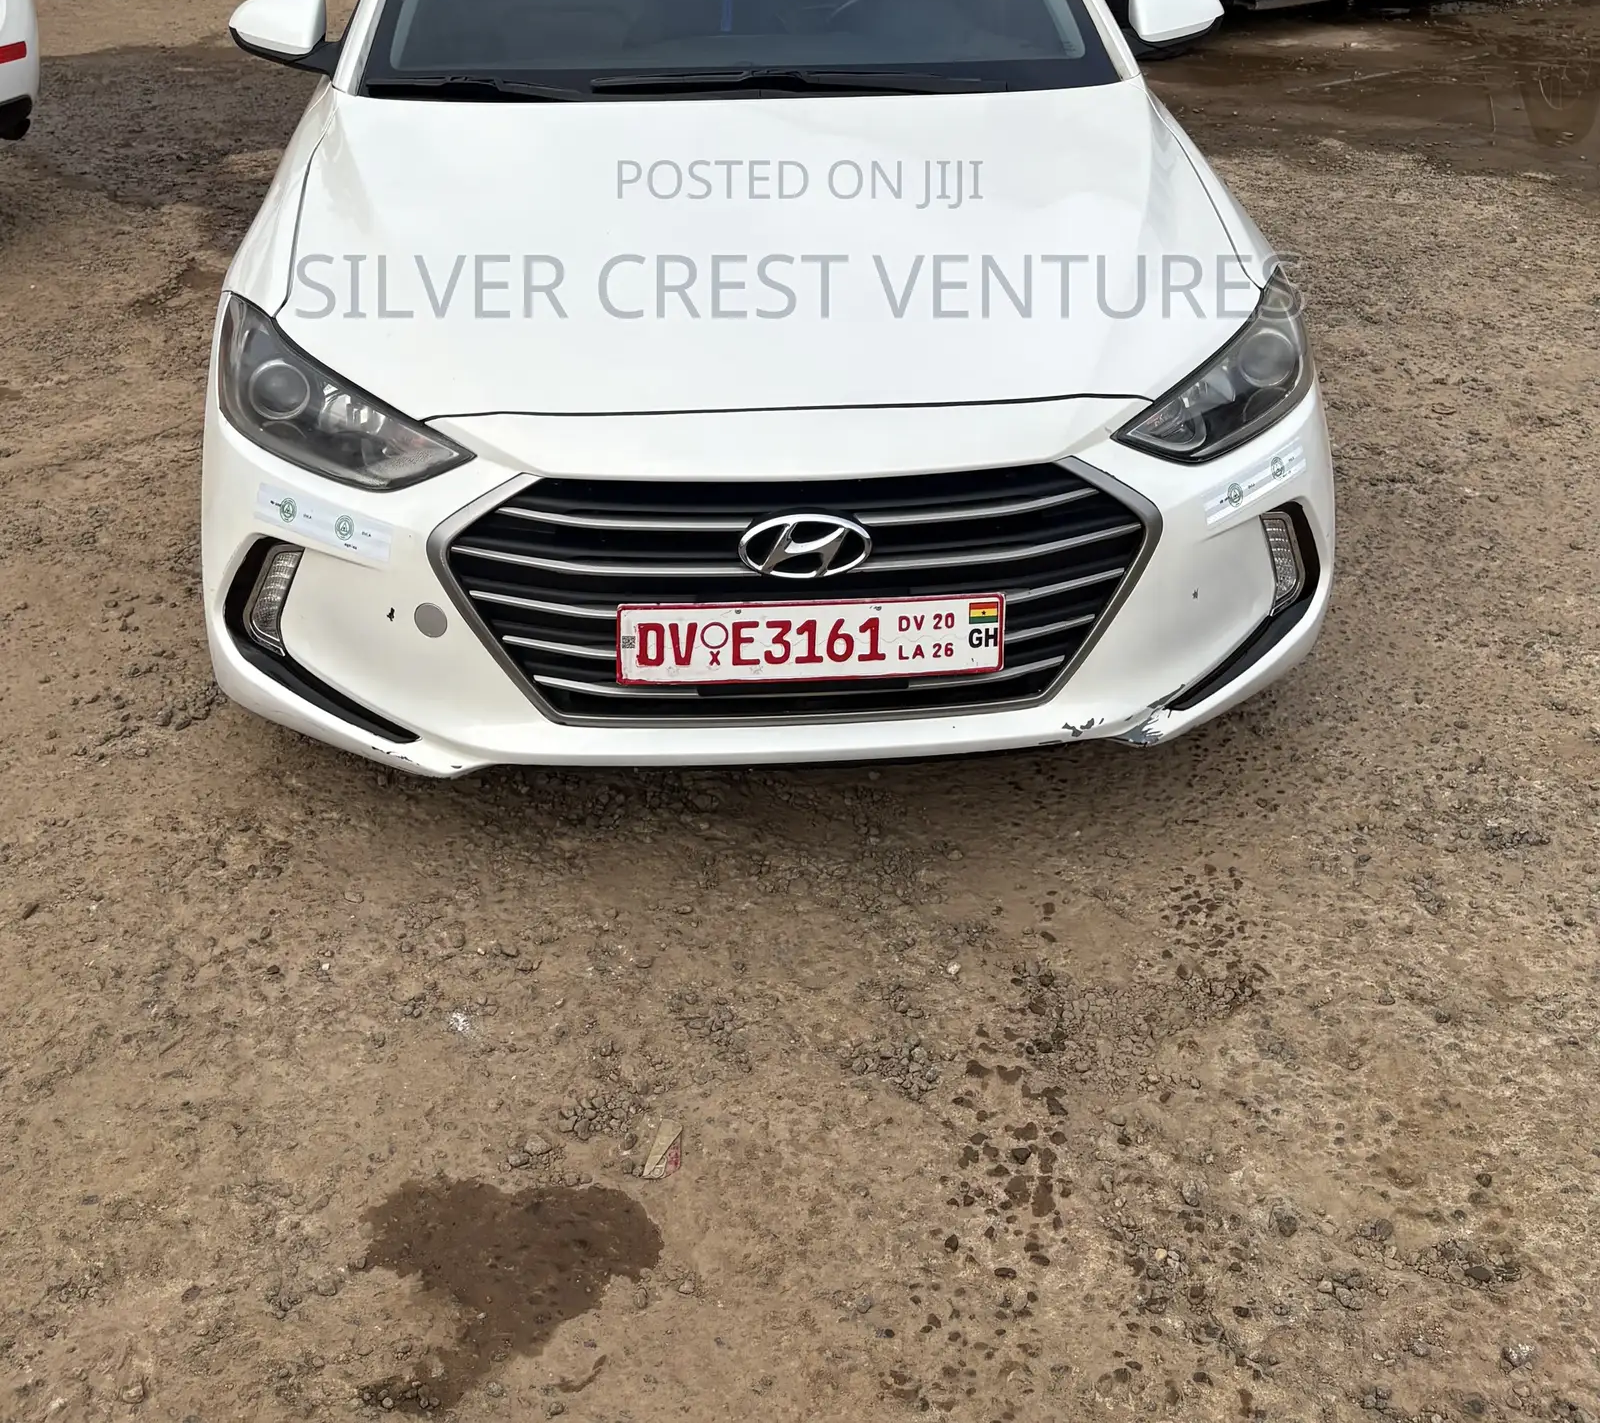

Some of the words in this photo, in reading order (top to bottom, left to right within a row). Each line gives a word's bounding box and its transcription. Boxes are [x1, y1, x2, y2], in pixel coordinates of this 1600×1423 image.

[898, 615, 925, 632] DV
[933, 612, 955, 630] 20
[969, 627, 999, 649] GH
[898, 644, 925, 661] LA
[932, 642, 954, 659] 26
